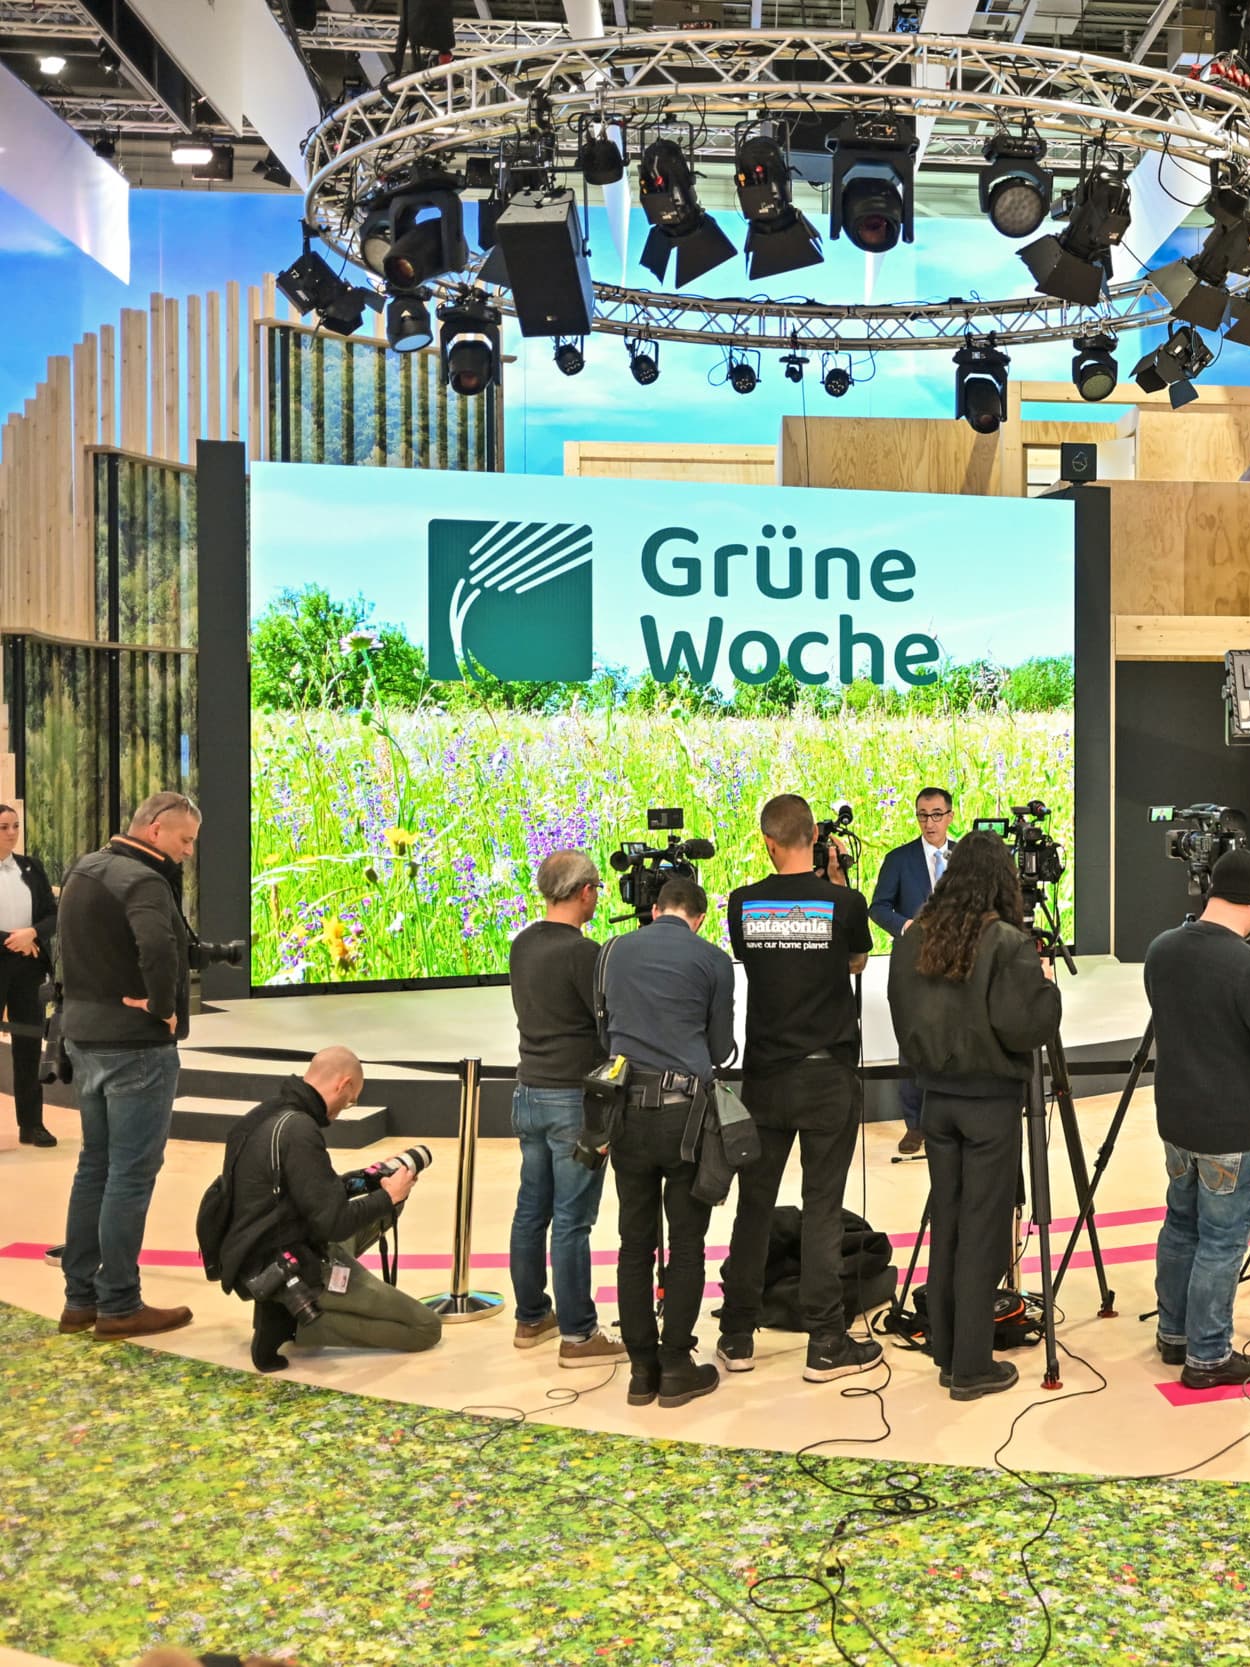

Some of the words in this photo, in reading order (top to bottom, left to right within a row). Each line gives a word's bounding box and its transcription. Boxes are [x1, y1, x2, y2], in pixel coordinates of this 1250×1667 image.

[641, 524, 916, 602] Grüne
[640, 614, 940, 686] Woche
[746, 919, 828, 935] patagonia
[779, 941, 802, 949] home
[803, 941, 828, 950] planet
